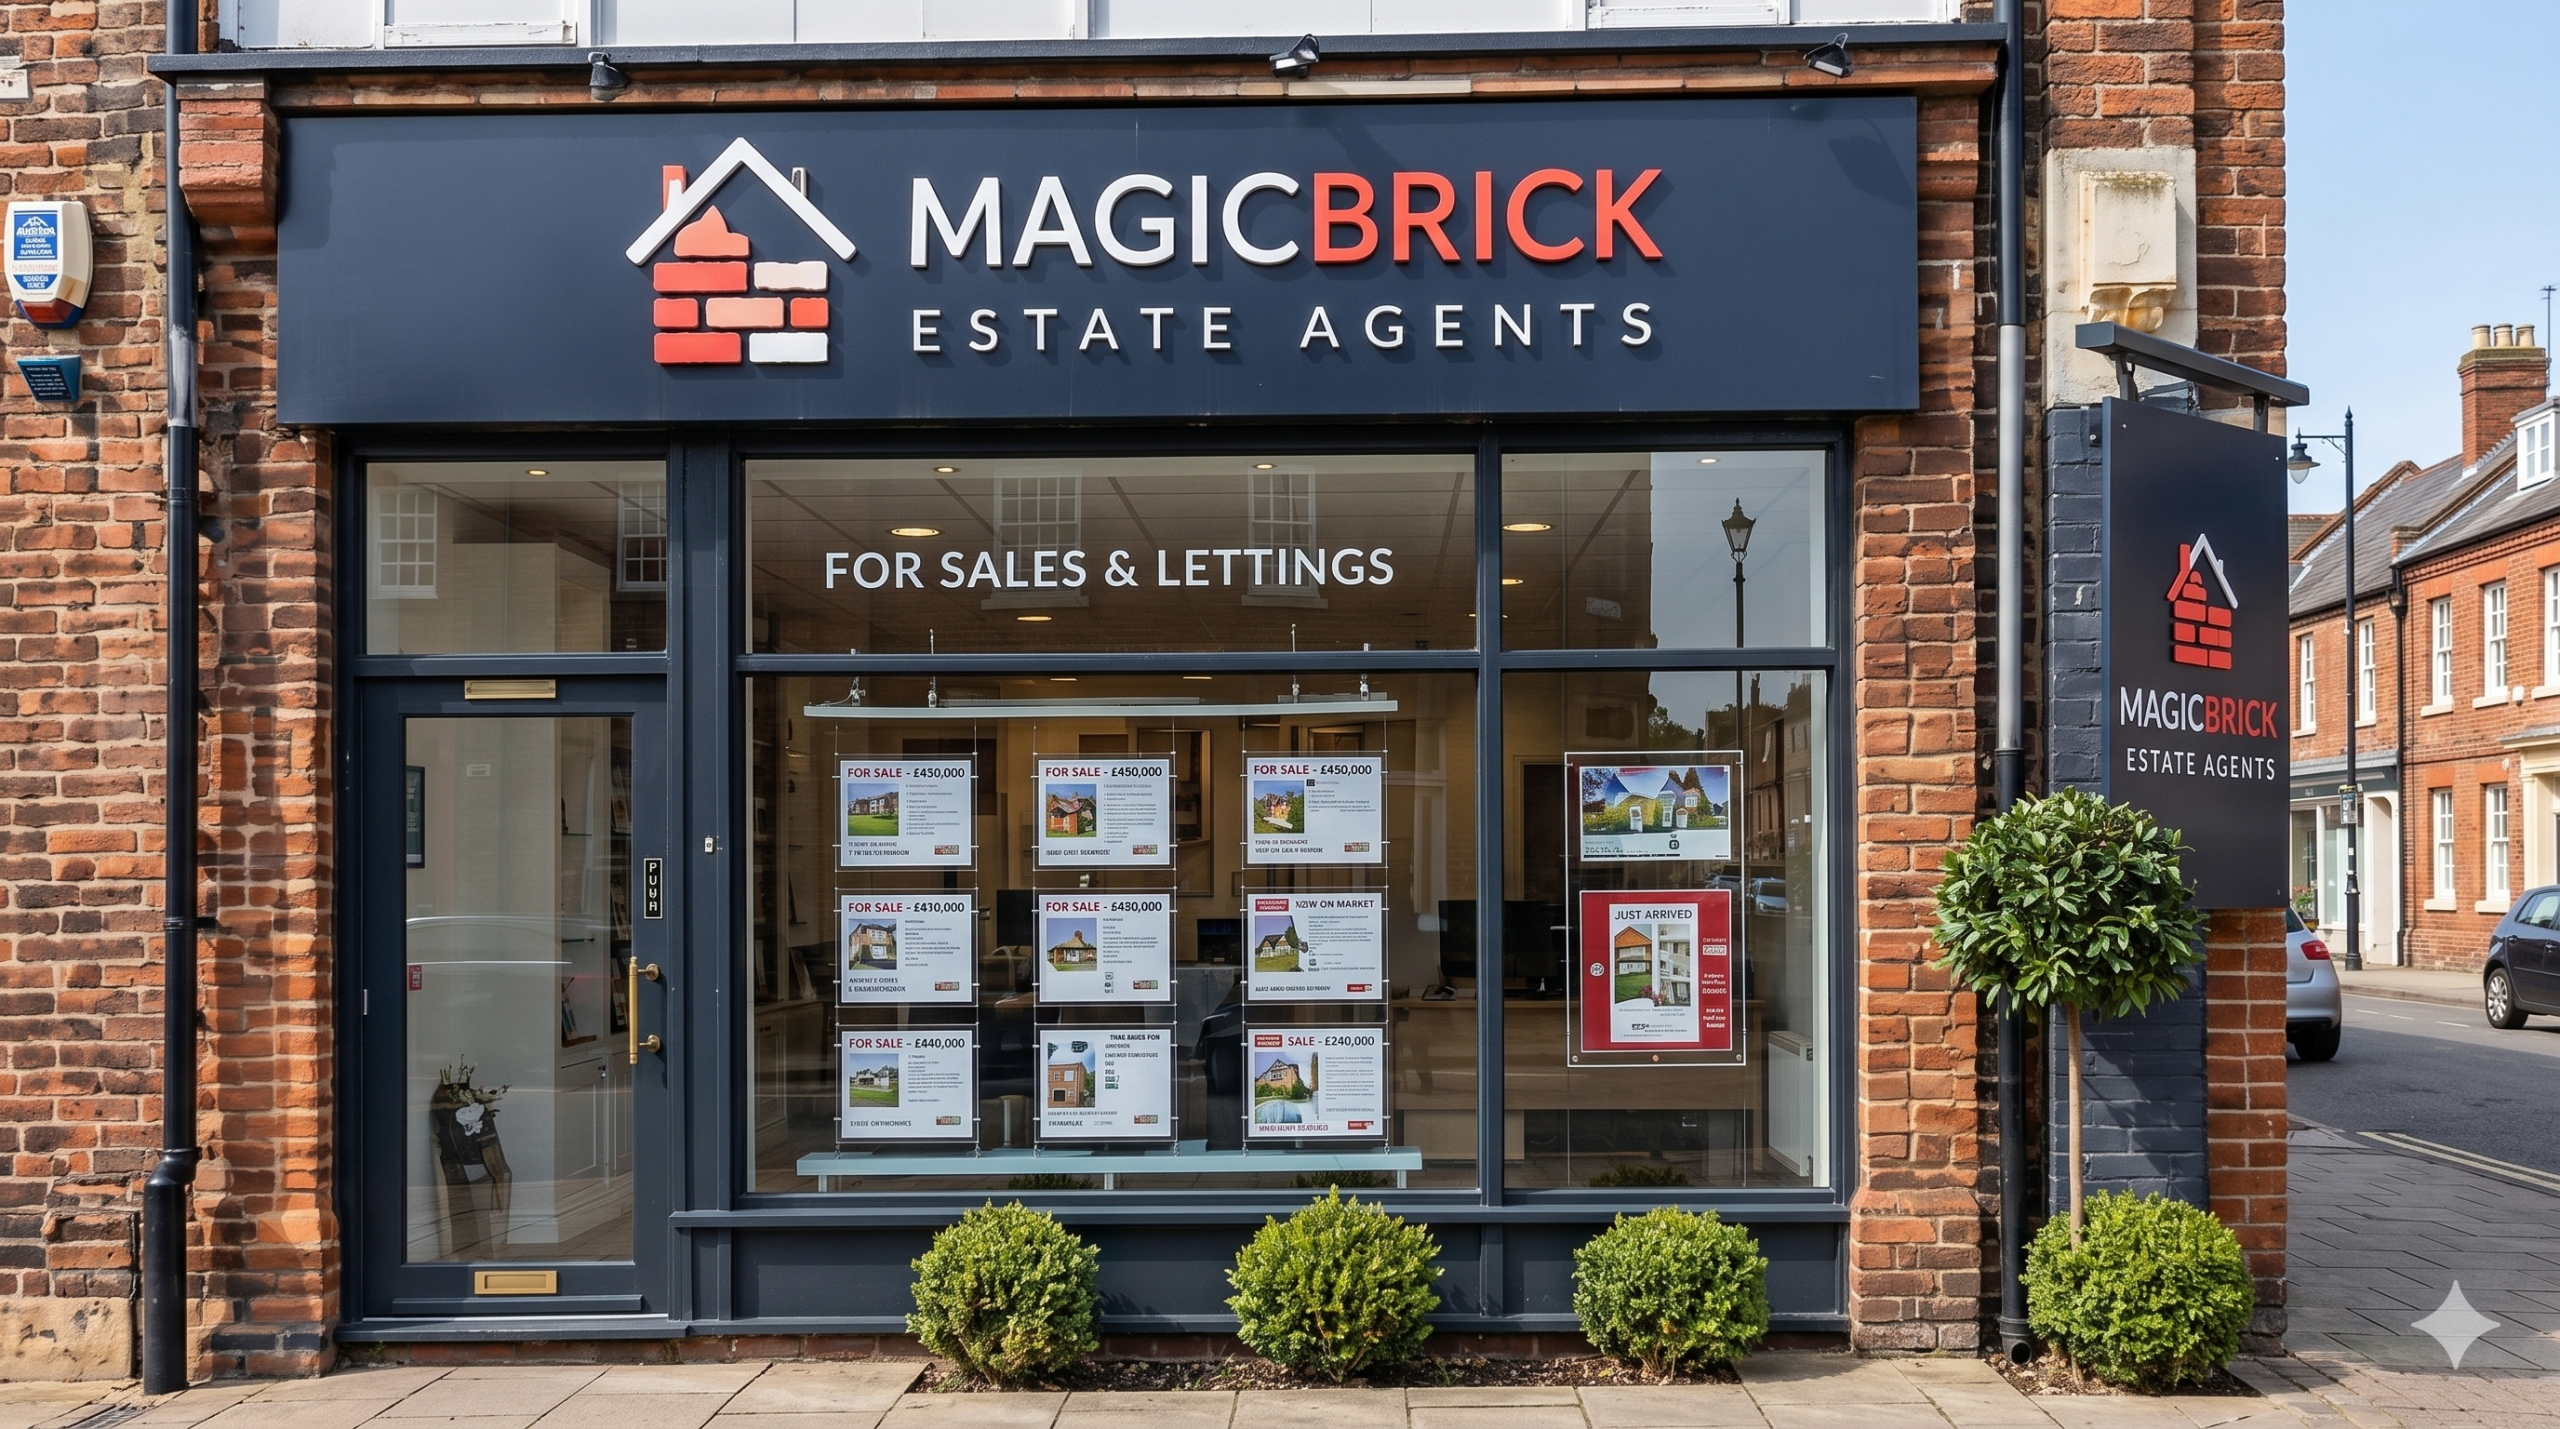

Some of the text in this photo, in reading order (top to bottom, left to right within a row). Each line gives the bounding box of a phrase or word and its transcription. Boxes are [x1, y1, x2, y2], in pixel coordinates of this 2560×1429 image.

[910, 168, 1663, 268] MAGICBRICK
[912, 302, 1653, 353] ESTATE AGENTS
[824, 547, 1394, 589] FOR SALES & LETTINGS
[2120, 686, 2278, 739] MAGICBRICK
[2126, 747, 2275, 781] ESTATE AGENTS
[847, 767, 871, 778] FOR
[873, 767, 903, 778] SALE
[1045, 766, 1069, 777] FOR
[1072, 766, 1101, 777] SALE
[1111, 766, 1162, 778] £450,000
[1253, 765, 1277, 775] FOR
[1280, 765, 1310, 775] SALE
[1320, 764, 1372, 777] £450,000
[848, 902, 872, 913] FOR
[874, 902, 903, 913] SALE
[1045, 901, 1069, 912] FOR
[1072, 901, 1101, 912] SALE
[1320, 900, 1334, 909] ON
[1336, 900, 1375, 908] MARKET
[1614, 909, 1693, 920] JUST ARRIVED
[849, 1038, 873, 1049] FOR
[875, 1038, 903, 1049] SALE
[914, 1038, 965, 1050] £440,000
[1288, 1036, 1315, 1046] SALE
[1324, 1036, 1375, 1048] £240,000
